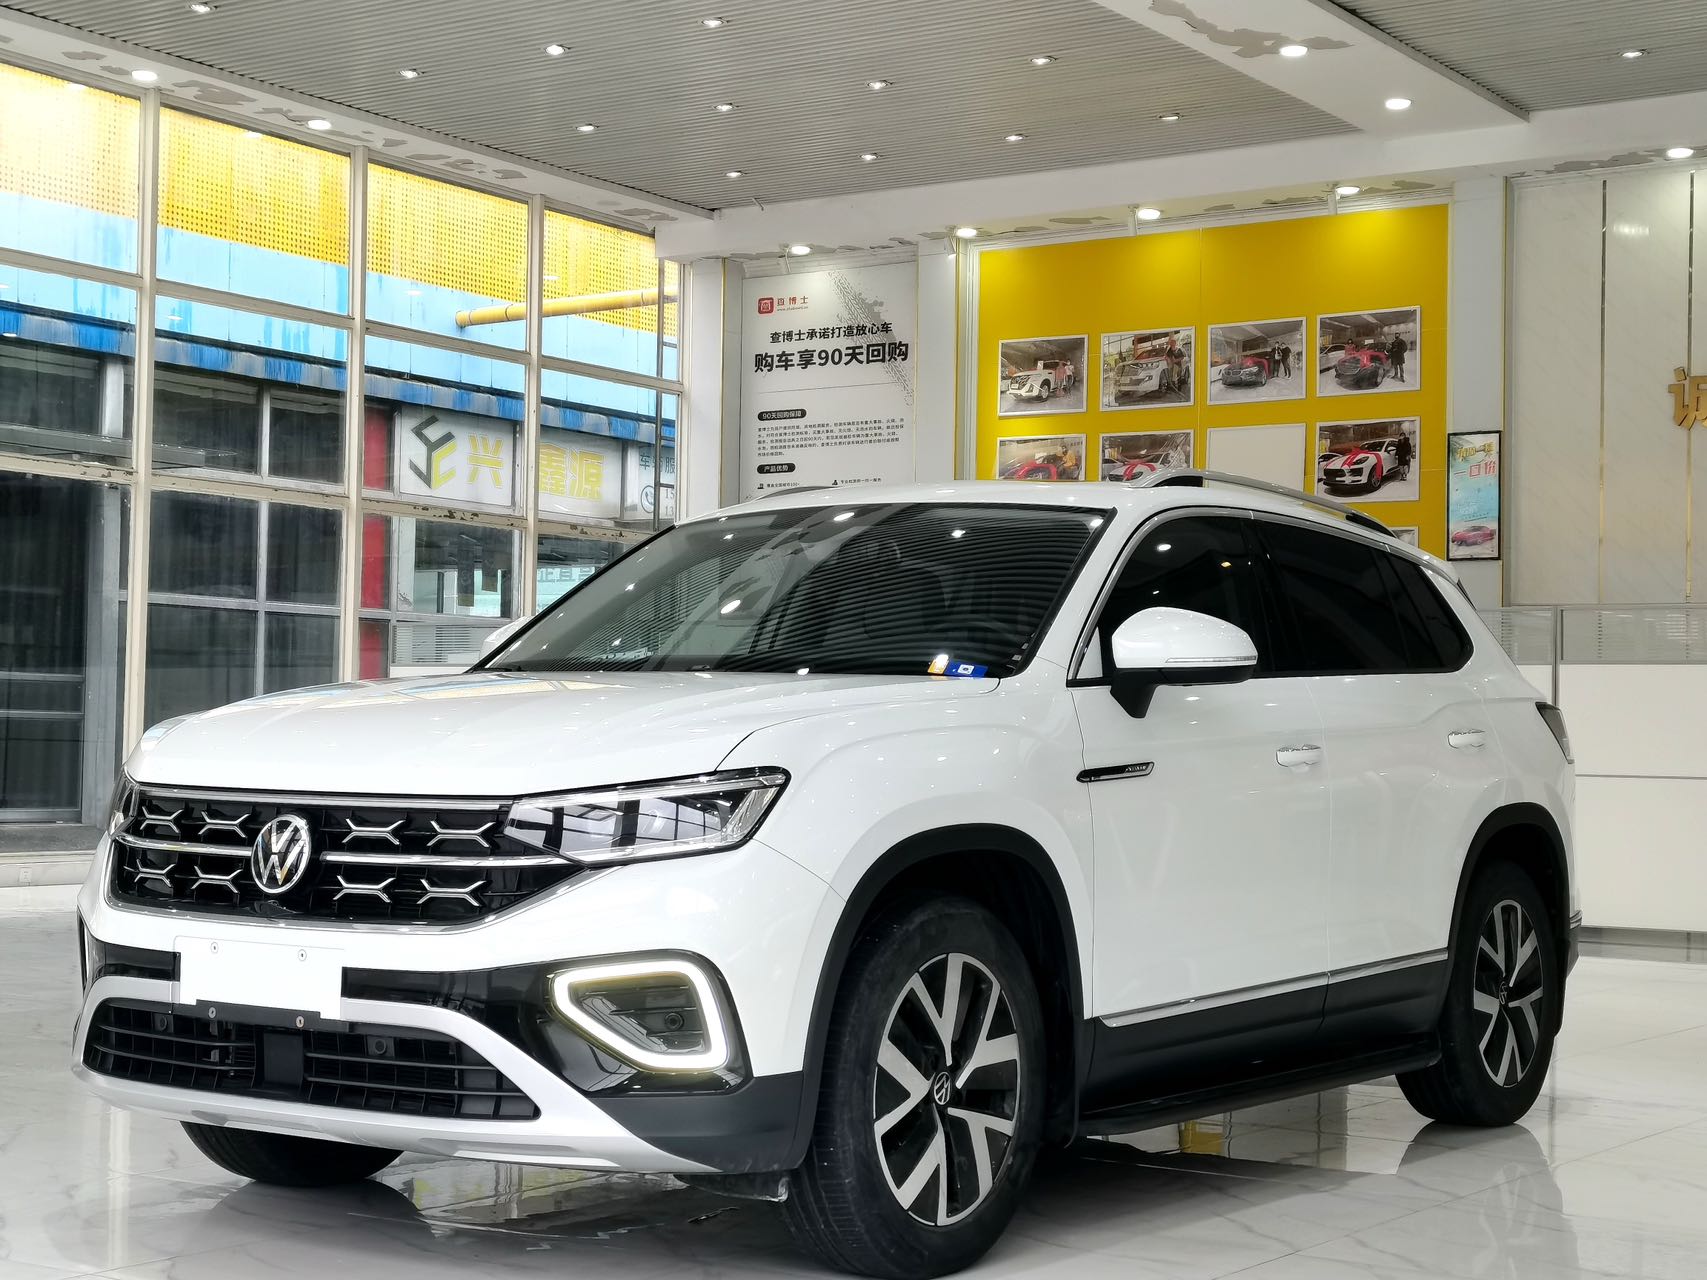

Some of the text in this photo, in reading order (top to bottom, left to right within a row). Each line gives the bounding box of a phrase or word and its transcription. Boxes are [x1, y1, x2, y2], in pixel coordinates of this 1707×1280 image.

[769, 321, 893, 344] 查博士承诺打造放心车
[754, 340, 909, 373] 购车享90天回购
[466, 432, 504, 490] 兴
